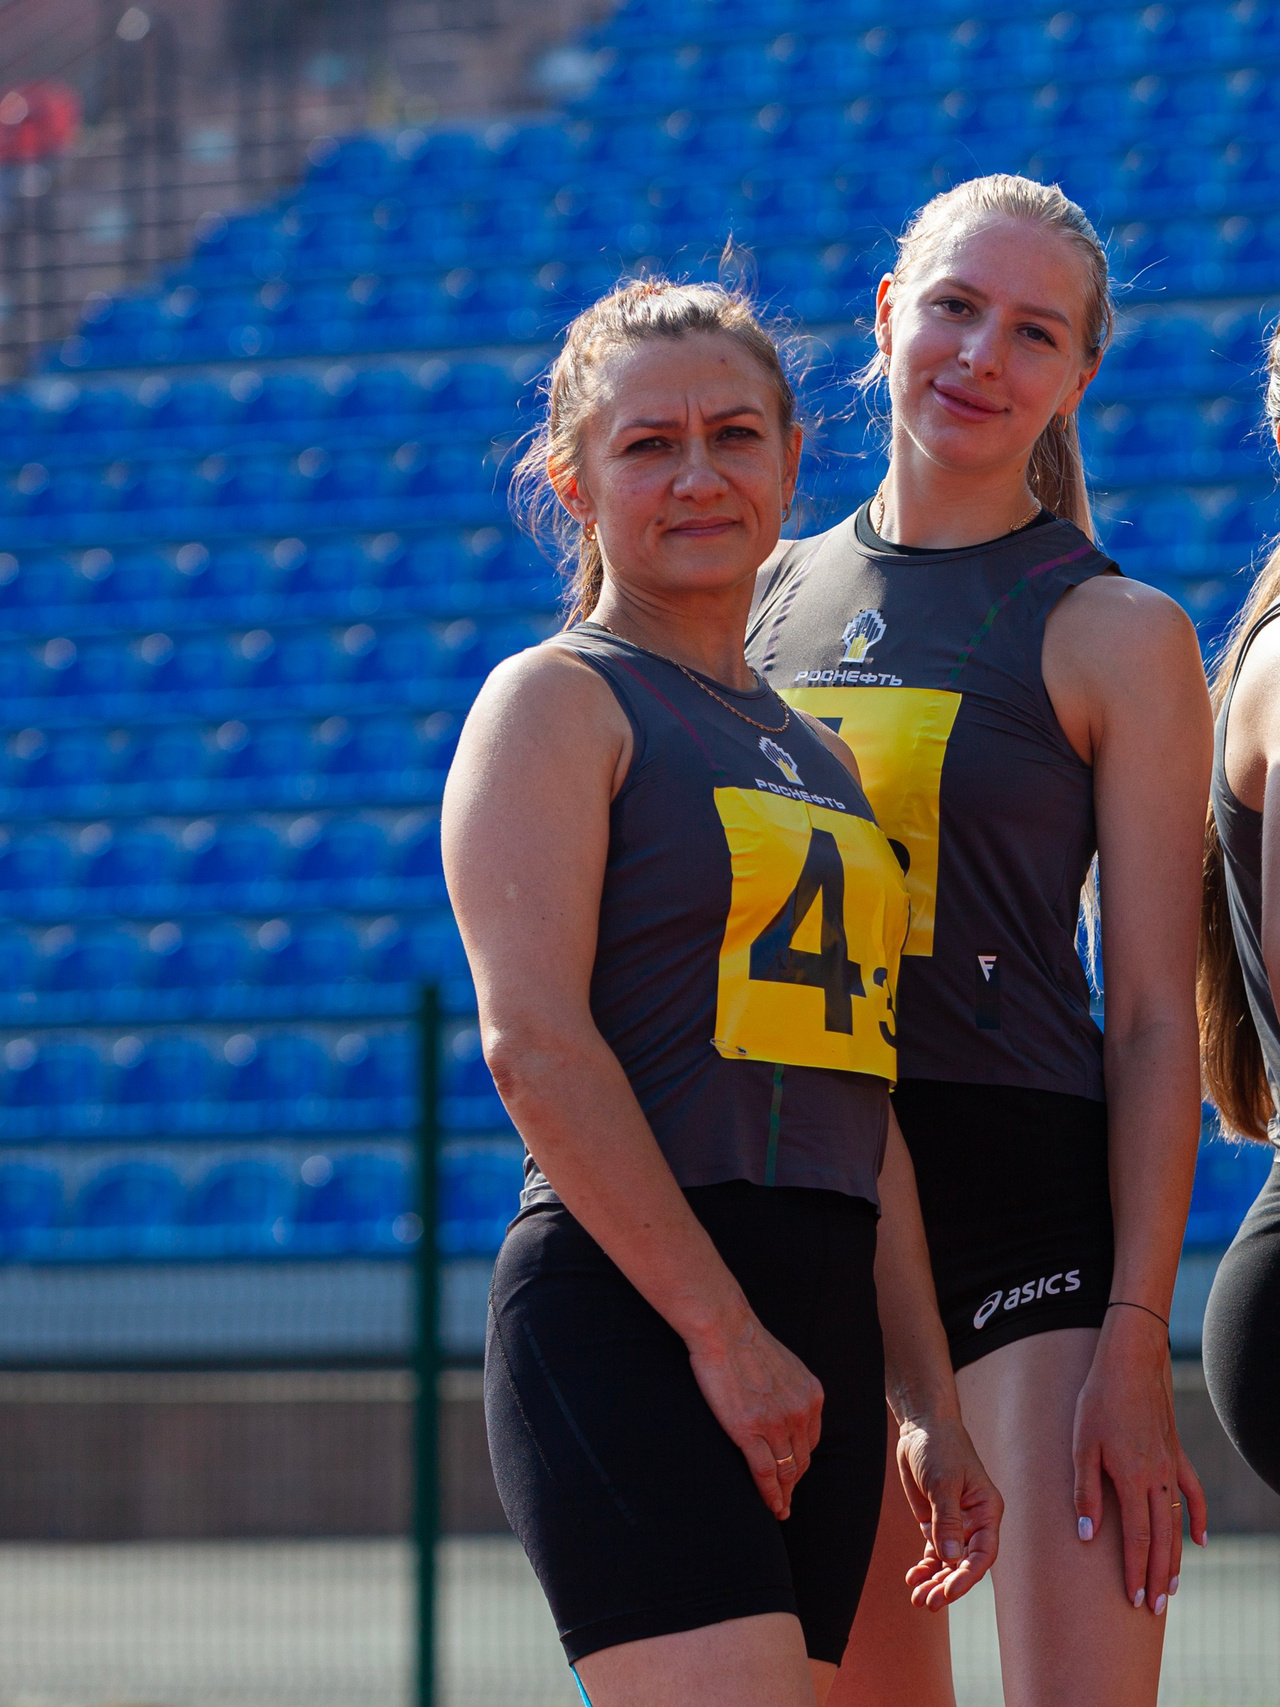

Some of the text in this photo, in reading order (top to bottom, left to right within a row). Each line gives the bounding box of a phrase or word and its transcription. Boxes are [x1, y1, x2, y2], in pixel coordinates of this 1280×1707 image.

[794, 670, 903, 687] РОСНЕФТЬ
[755, 778, 846, 810] РОСНЕФТЬ
[749, 827, 867, 1036] 4
